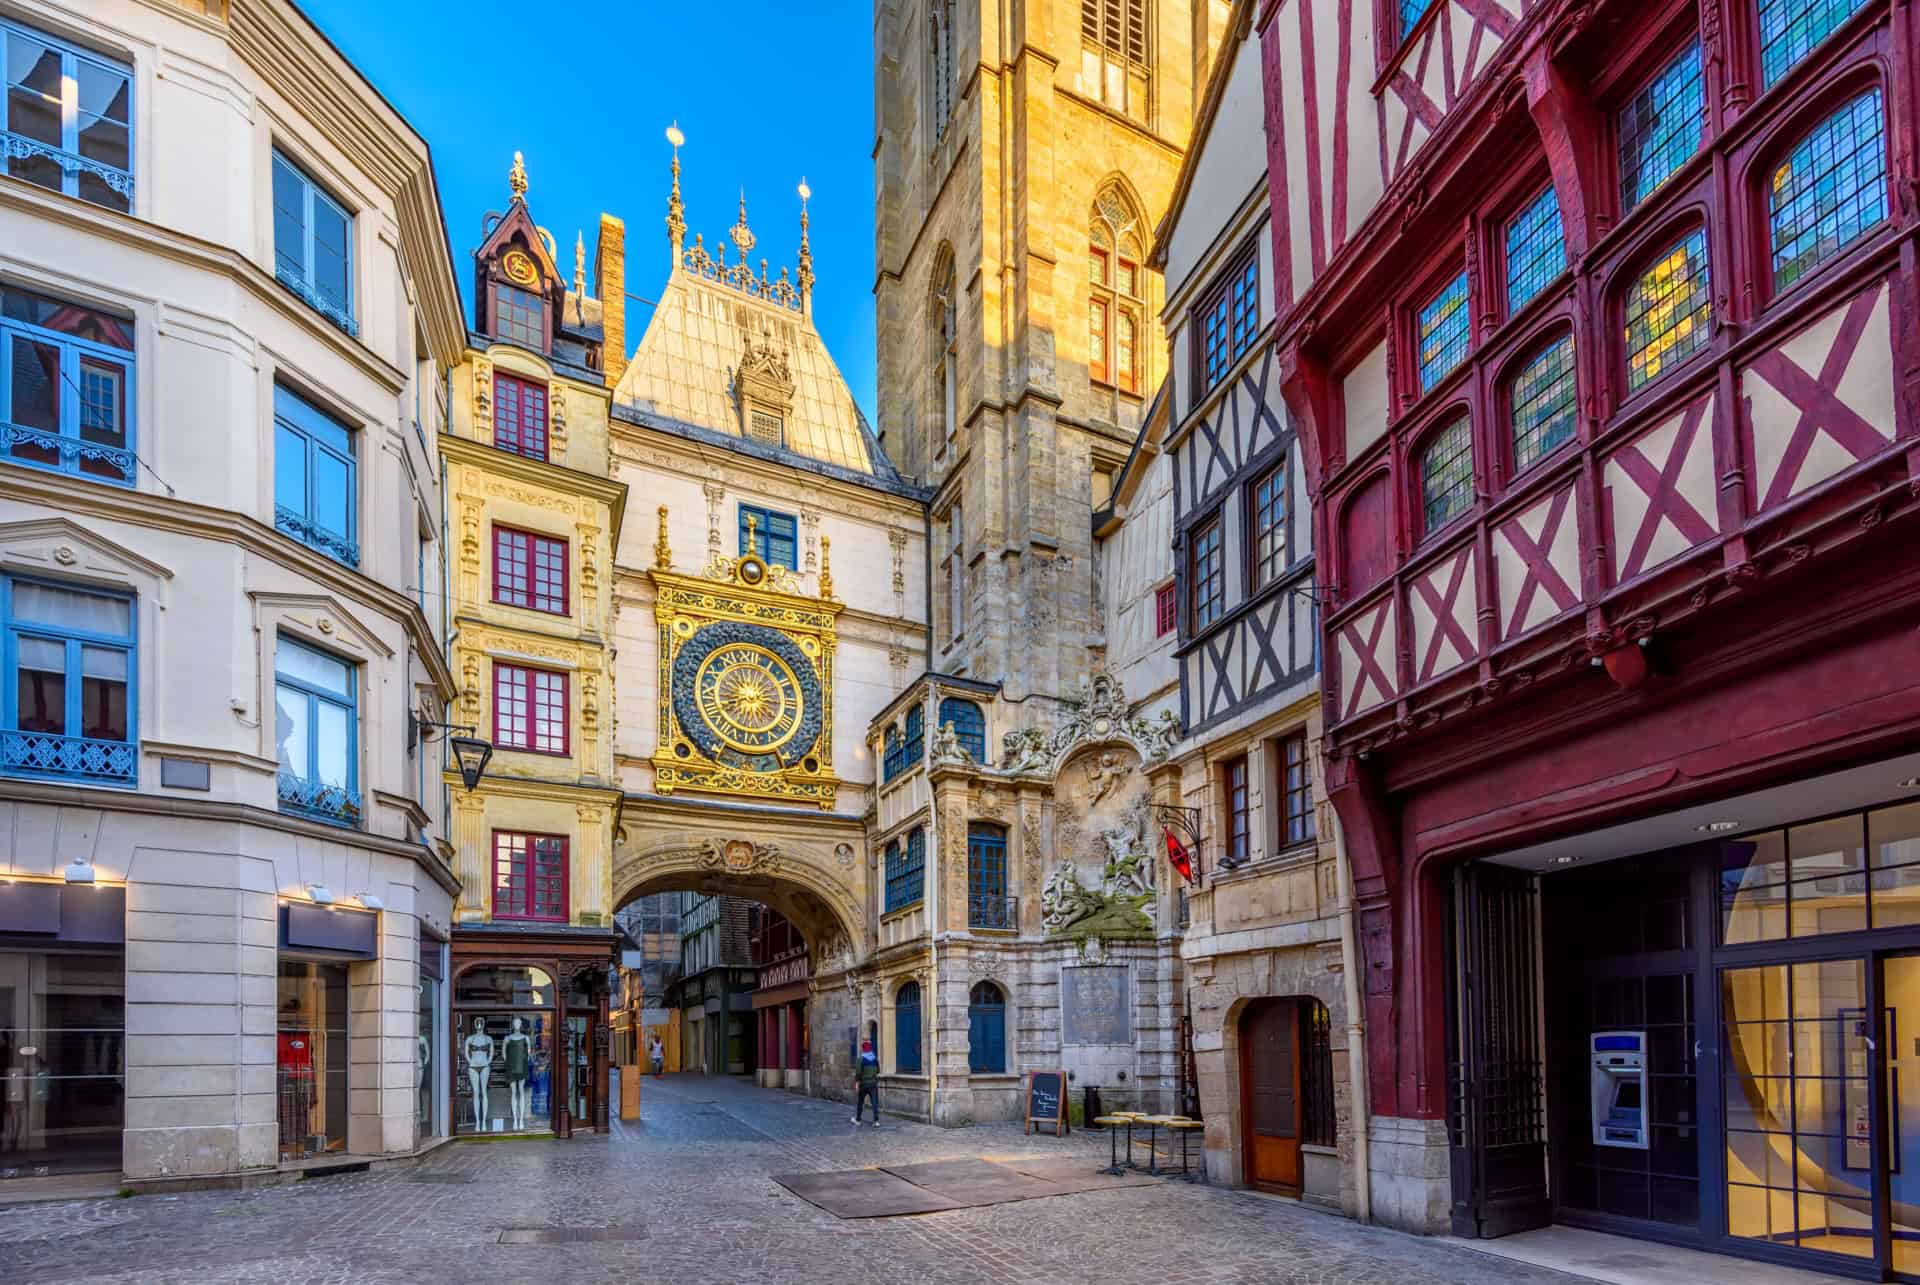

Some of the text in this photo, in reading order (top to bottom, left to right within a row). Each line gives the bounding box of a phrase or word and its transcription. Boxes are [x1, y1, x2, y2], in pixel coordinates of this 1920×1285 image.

[740, 651, 759, 665] XII
[778, 678, 791, 687] II
[784, 698, 797, 710] III
[768, 731, 779, 743] V
